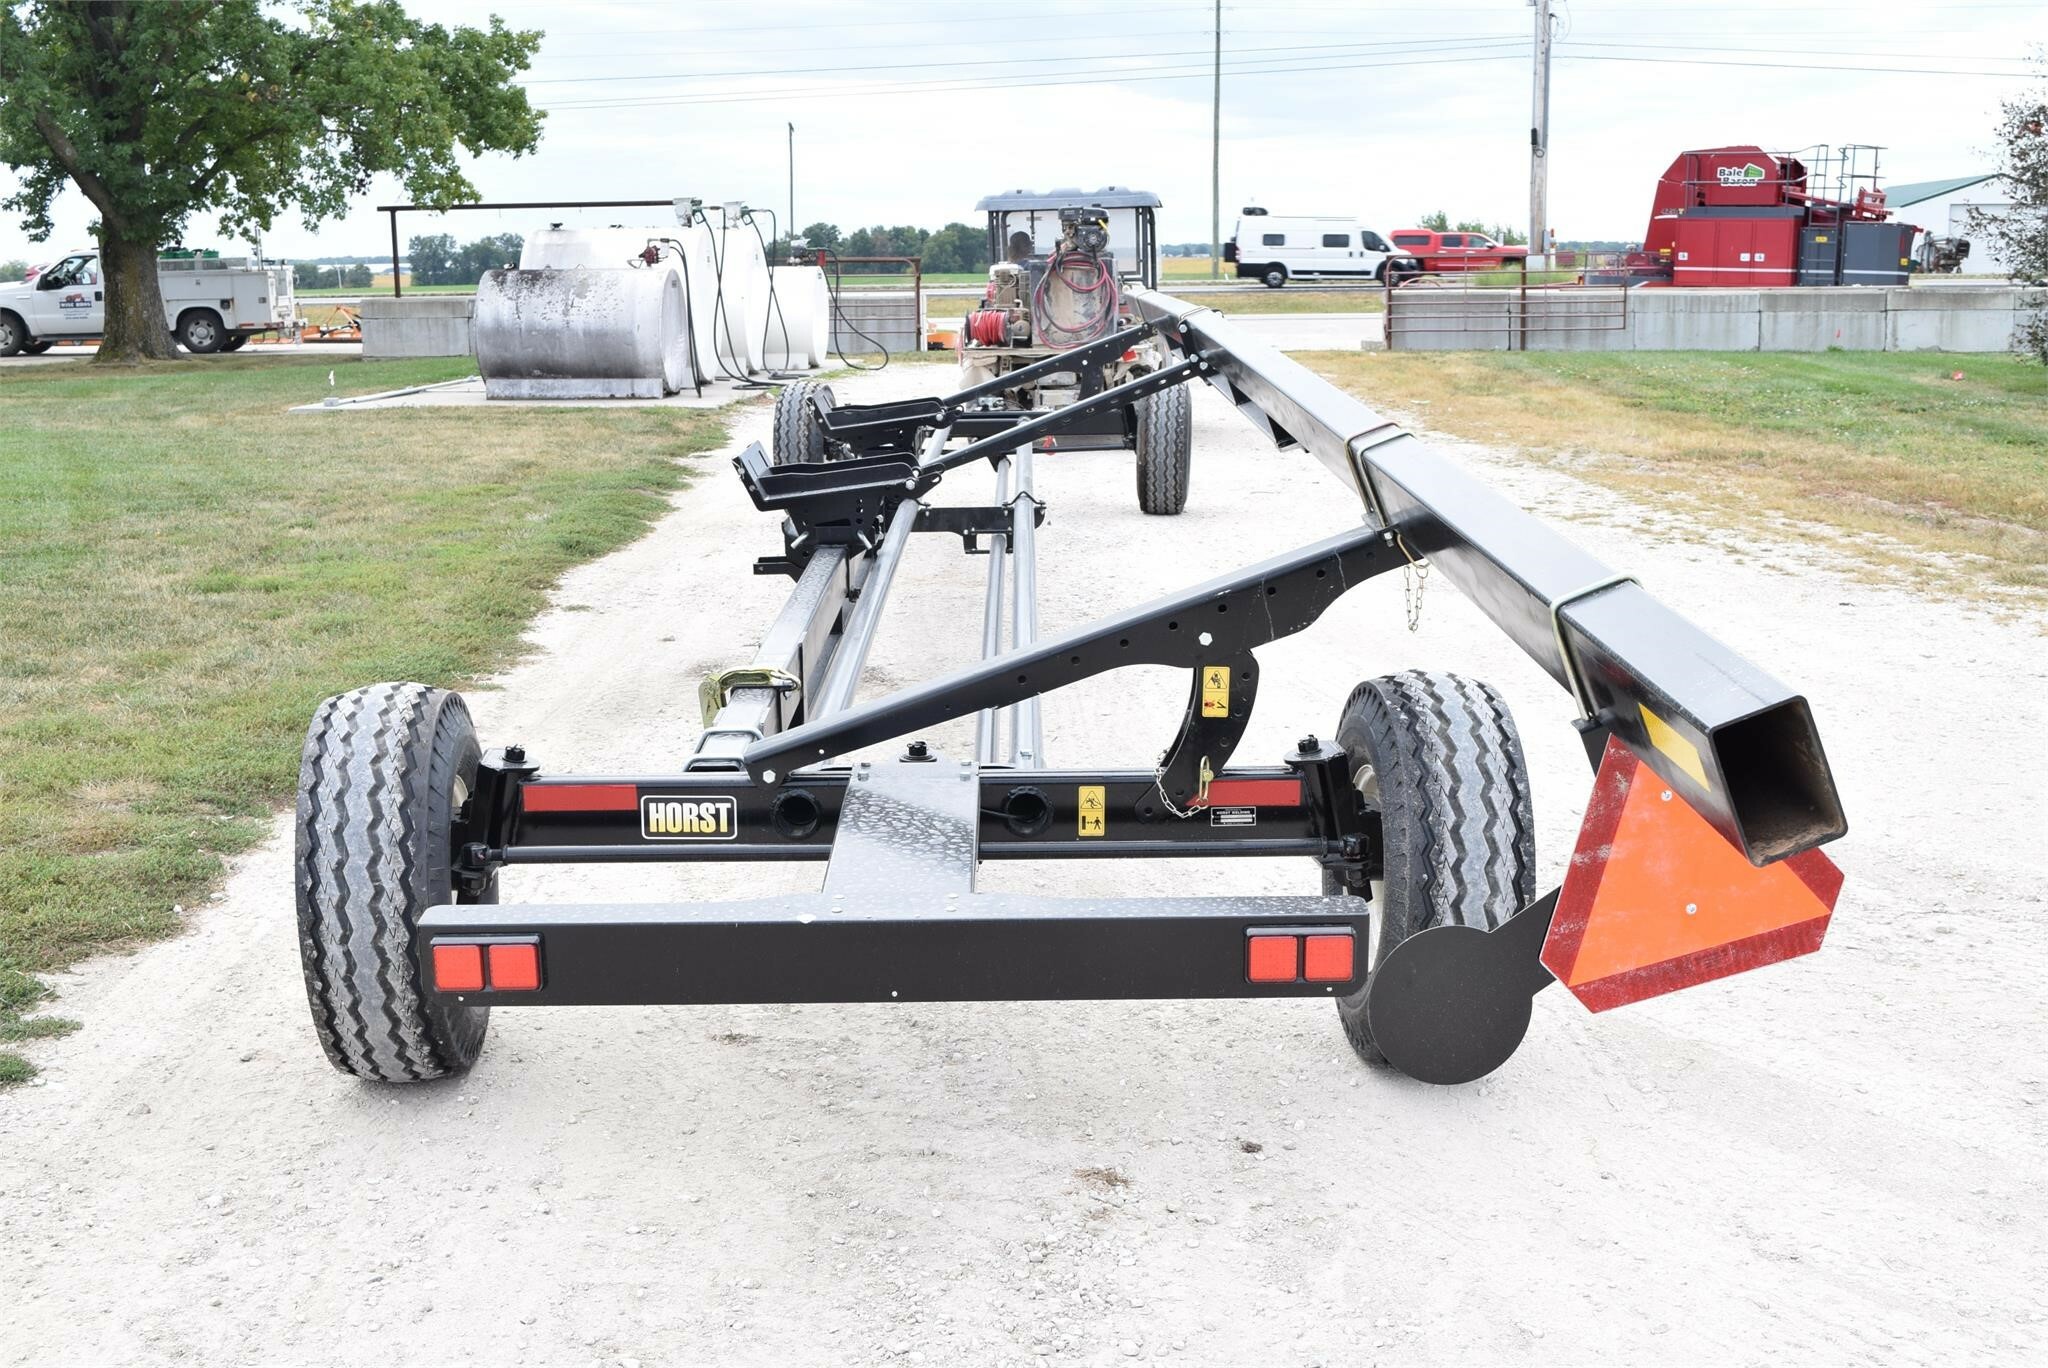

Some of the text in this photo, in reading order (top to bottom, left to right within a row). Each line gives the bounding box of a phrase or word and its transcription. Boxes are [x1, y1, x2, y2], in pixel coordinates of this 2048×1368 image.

[1719, 168, 1743, 177] Bale
[1722, 177, 1756, 185] Baron
[649, 802, 731, 833] HORST
